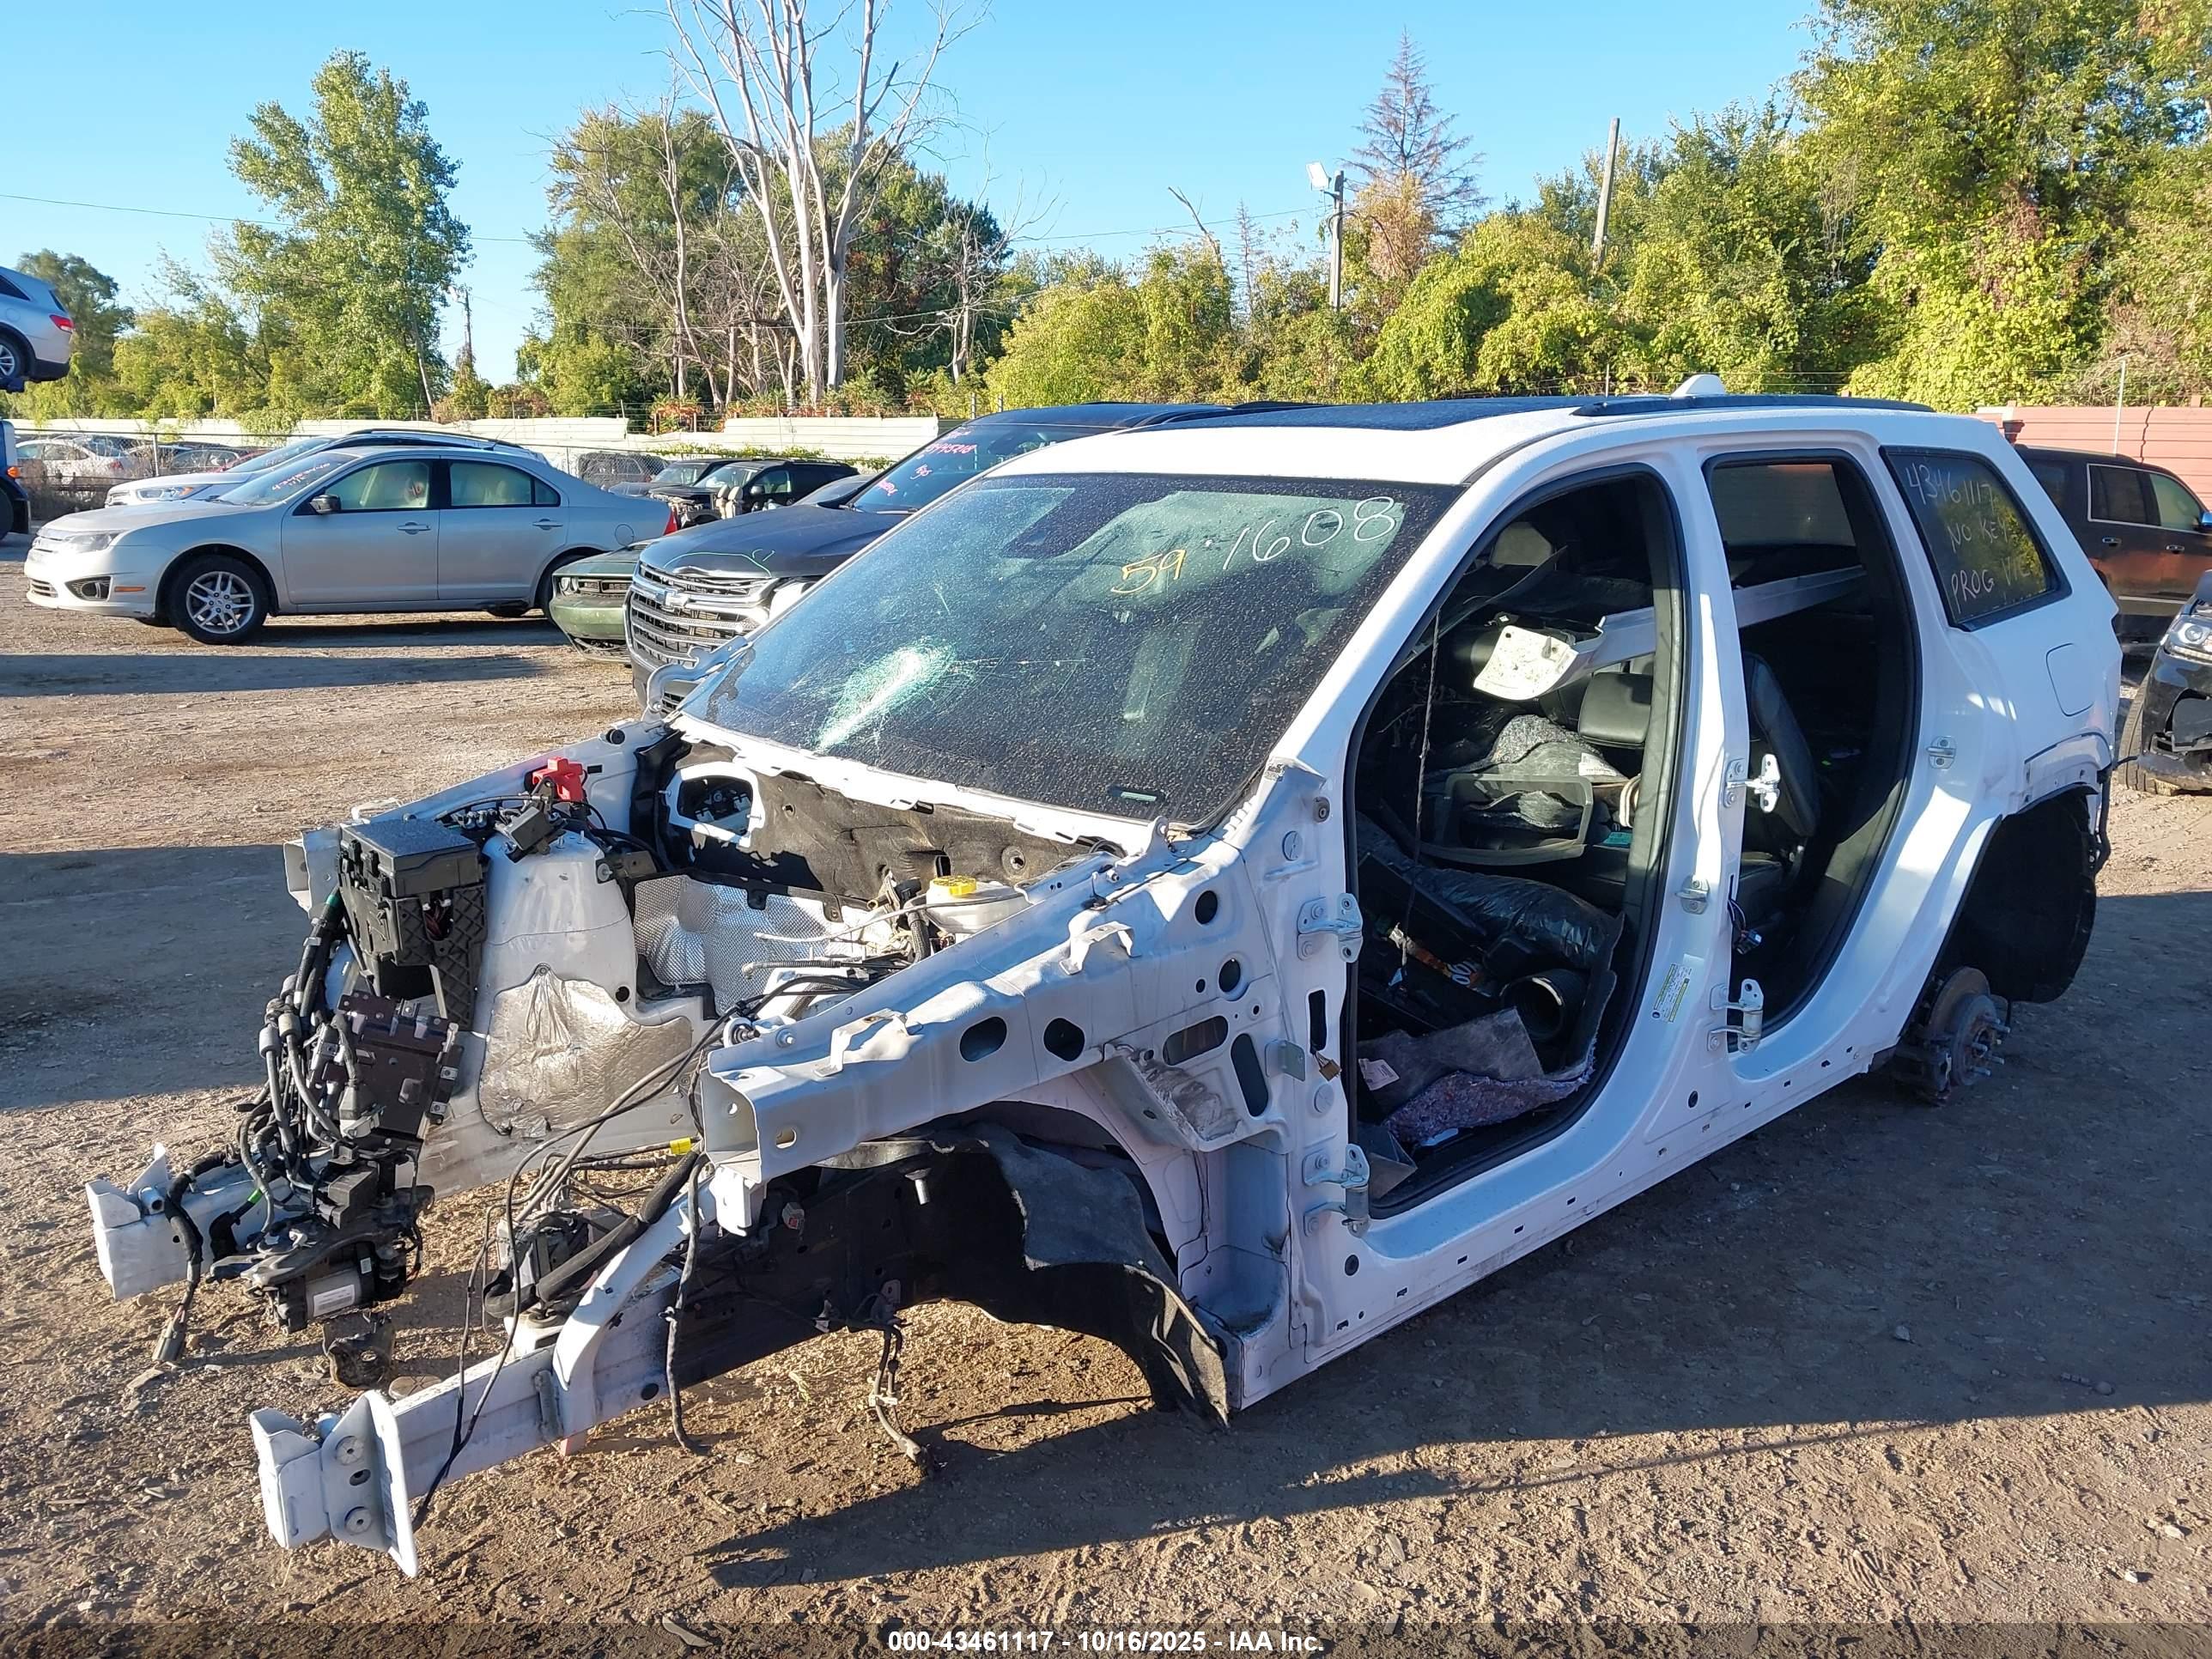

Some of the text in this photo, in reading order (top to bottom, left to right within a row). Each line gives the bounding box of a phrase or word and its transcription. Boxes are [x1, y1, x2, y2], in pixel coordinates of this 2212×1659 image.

[1905, 462, 1995, 516] 43461117
[1221, 495, 1397, 571] 1608
[1947, 515, 2008, 554] NO KEY
[1110, 549, 1188, 594] 59
[1951, 568, 1996, 614] PROG
